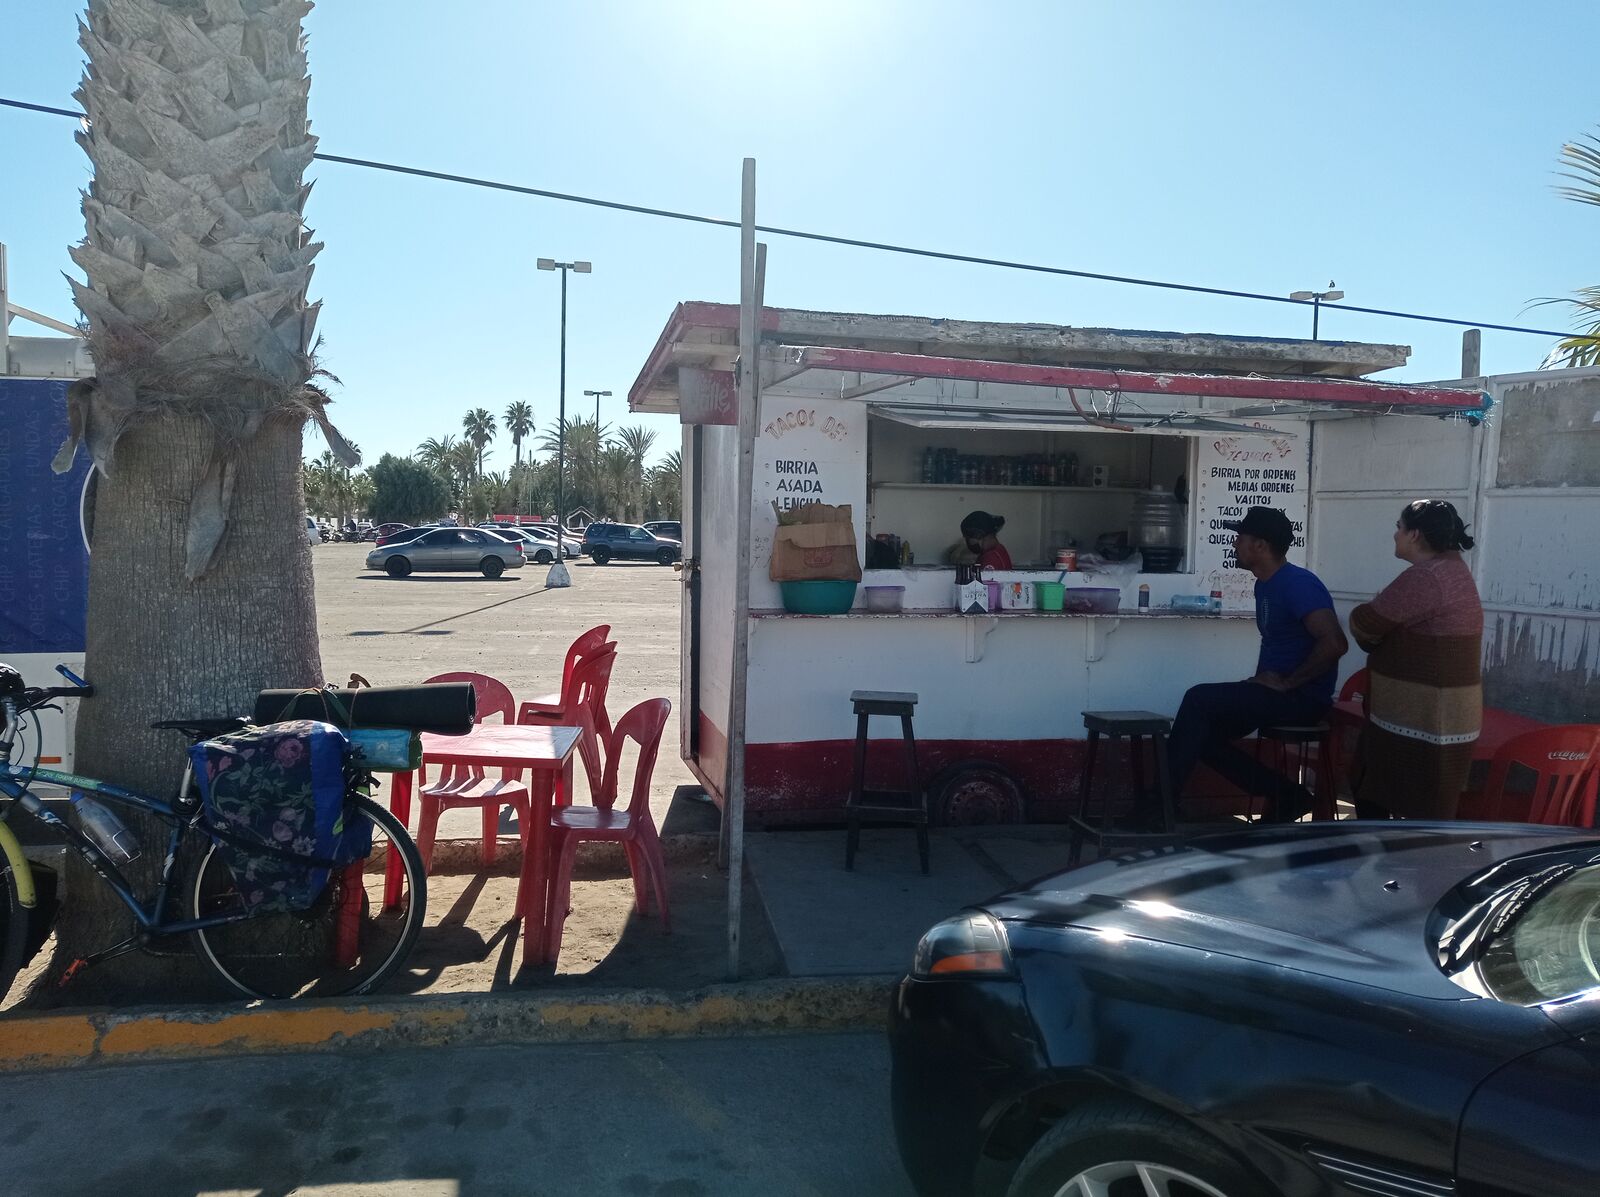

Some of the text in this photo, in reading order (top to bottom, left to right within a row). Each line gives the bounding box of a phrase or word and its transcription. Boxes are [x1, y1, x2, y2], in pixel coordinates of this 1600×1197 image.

[764, 408, 816, 440] TACOS
[24, 410, 40, 478] FUNDAS
[776, 460, 819, 475] BIRRIA
[1211, 467, 1296, 481] BIRRIA POR ORDENES
[776, 478, 823, 494] ASADA
[1228, 481, 1295, 493] MEDIAS ORDENES
[1235, 495, 1271, 505] VASITOS
[1217, 506, 1242, 517] TACOS
[54, 564, 70, 602] CHIP
